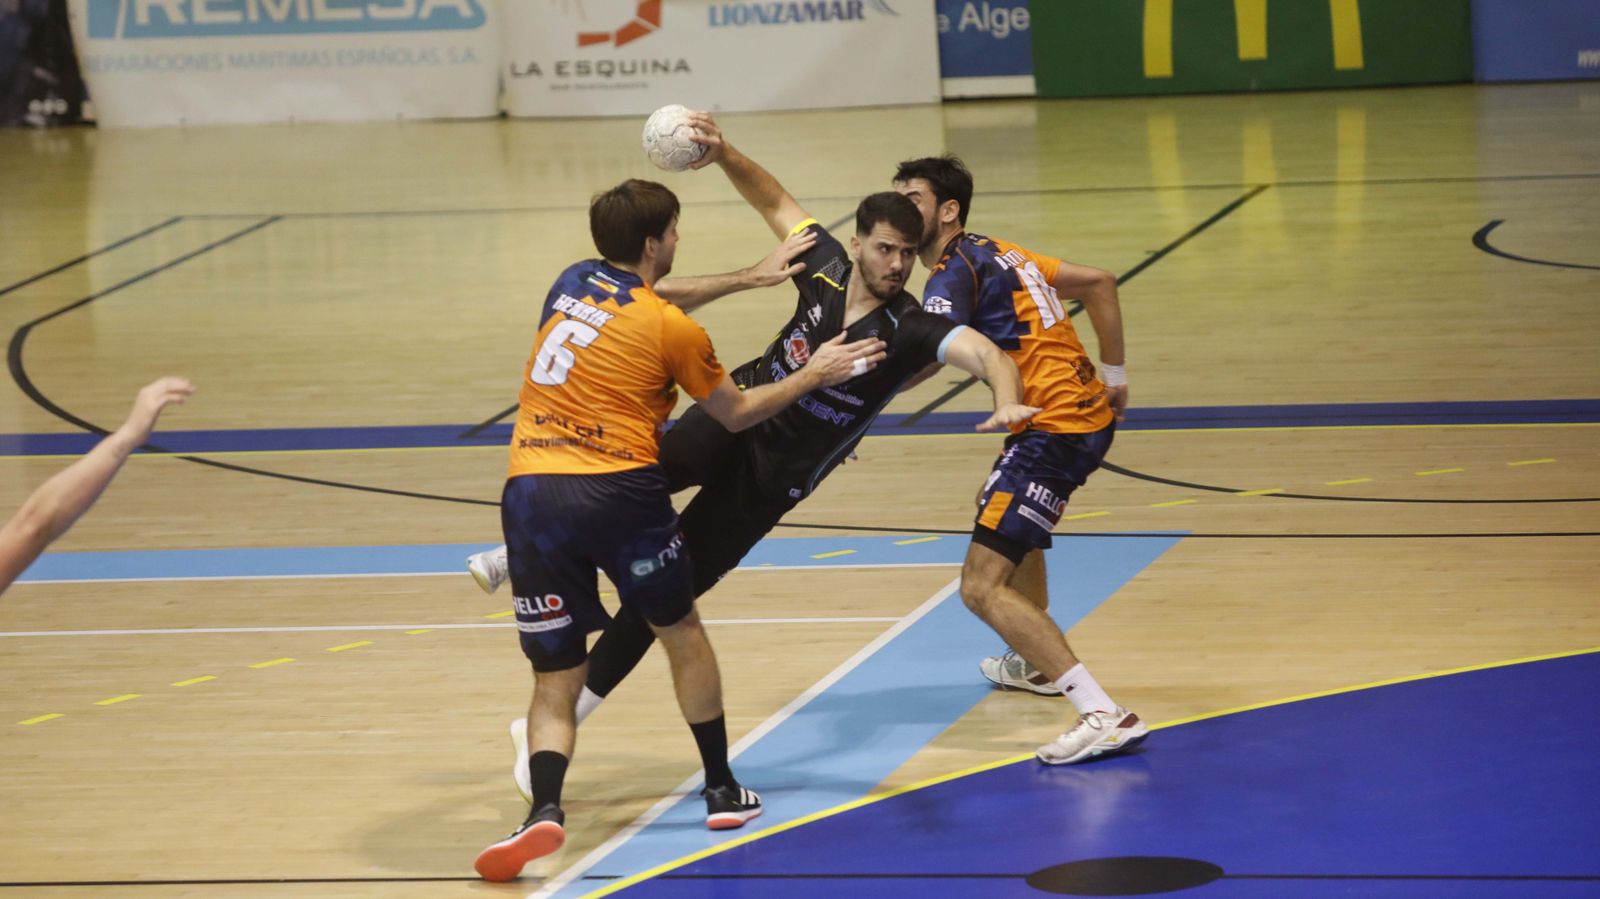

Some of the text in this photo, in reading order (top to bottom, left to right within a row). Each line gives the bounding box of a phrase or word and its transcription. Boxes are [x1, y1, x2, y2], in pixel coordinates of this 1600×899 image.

[709, 0, 864, 27] LIONZAMAR
[510, 58, 691, 78] LA ESQUINA
[530, 319, 600, 386] 6
